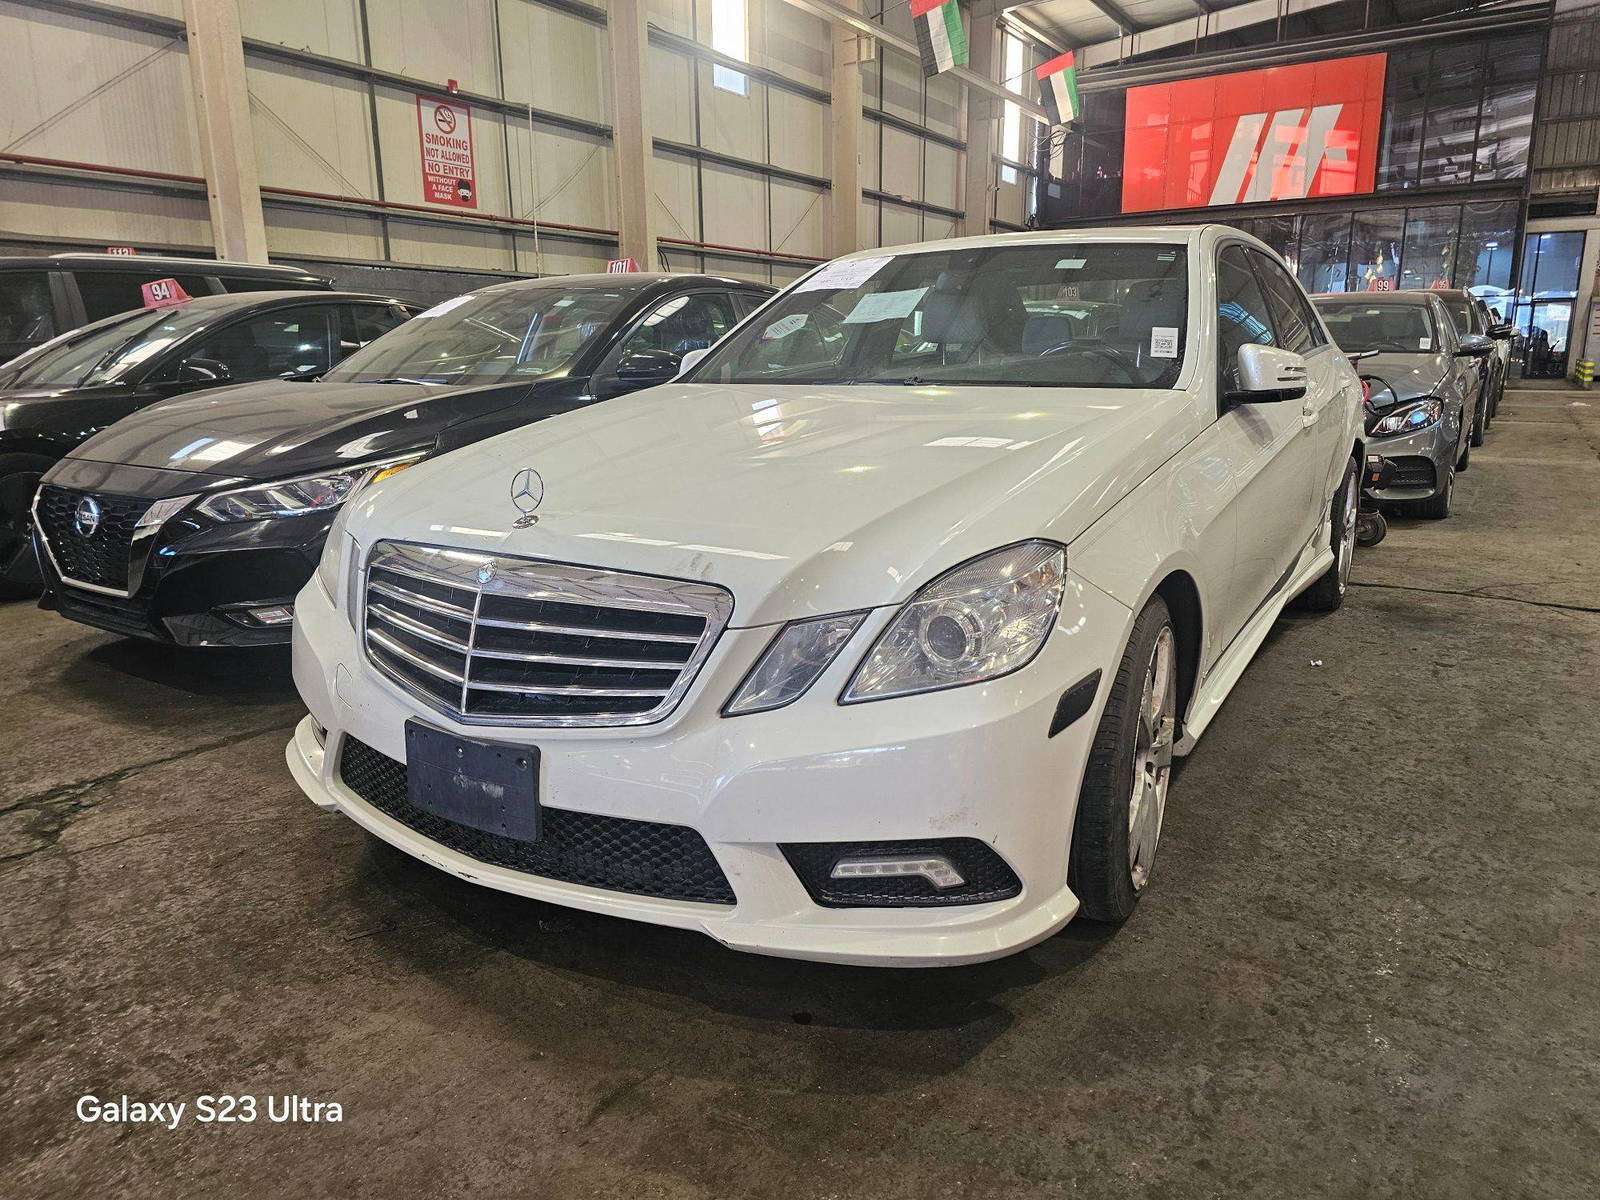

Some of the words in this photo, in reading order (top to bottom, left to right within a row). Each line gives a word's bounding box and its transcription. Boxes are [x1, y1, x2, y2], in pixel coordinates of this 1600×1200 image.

[425, 133, 468, 150] SMOKING
[425, 147, 439, 159] NOT
[440, 150, 469, 164] ALLOWED
[427, 162, 440, 173] NO
[443, 165, 470, 178] ENTRY
[428, 175, 456, 186] WITHOUT
[438, 184, 453, 193] FACE
[434, 191, 452, 200] MASK
[151, 282, 170, 300] 94
[1377, 280, 1389, 291] 99
[1064, 286, 1077, 297] 103
